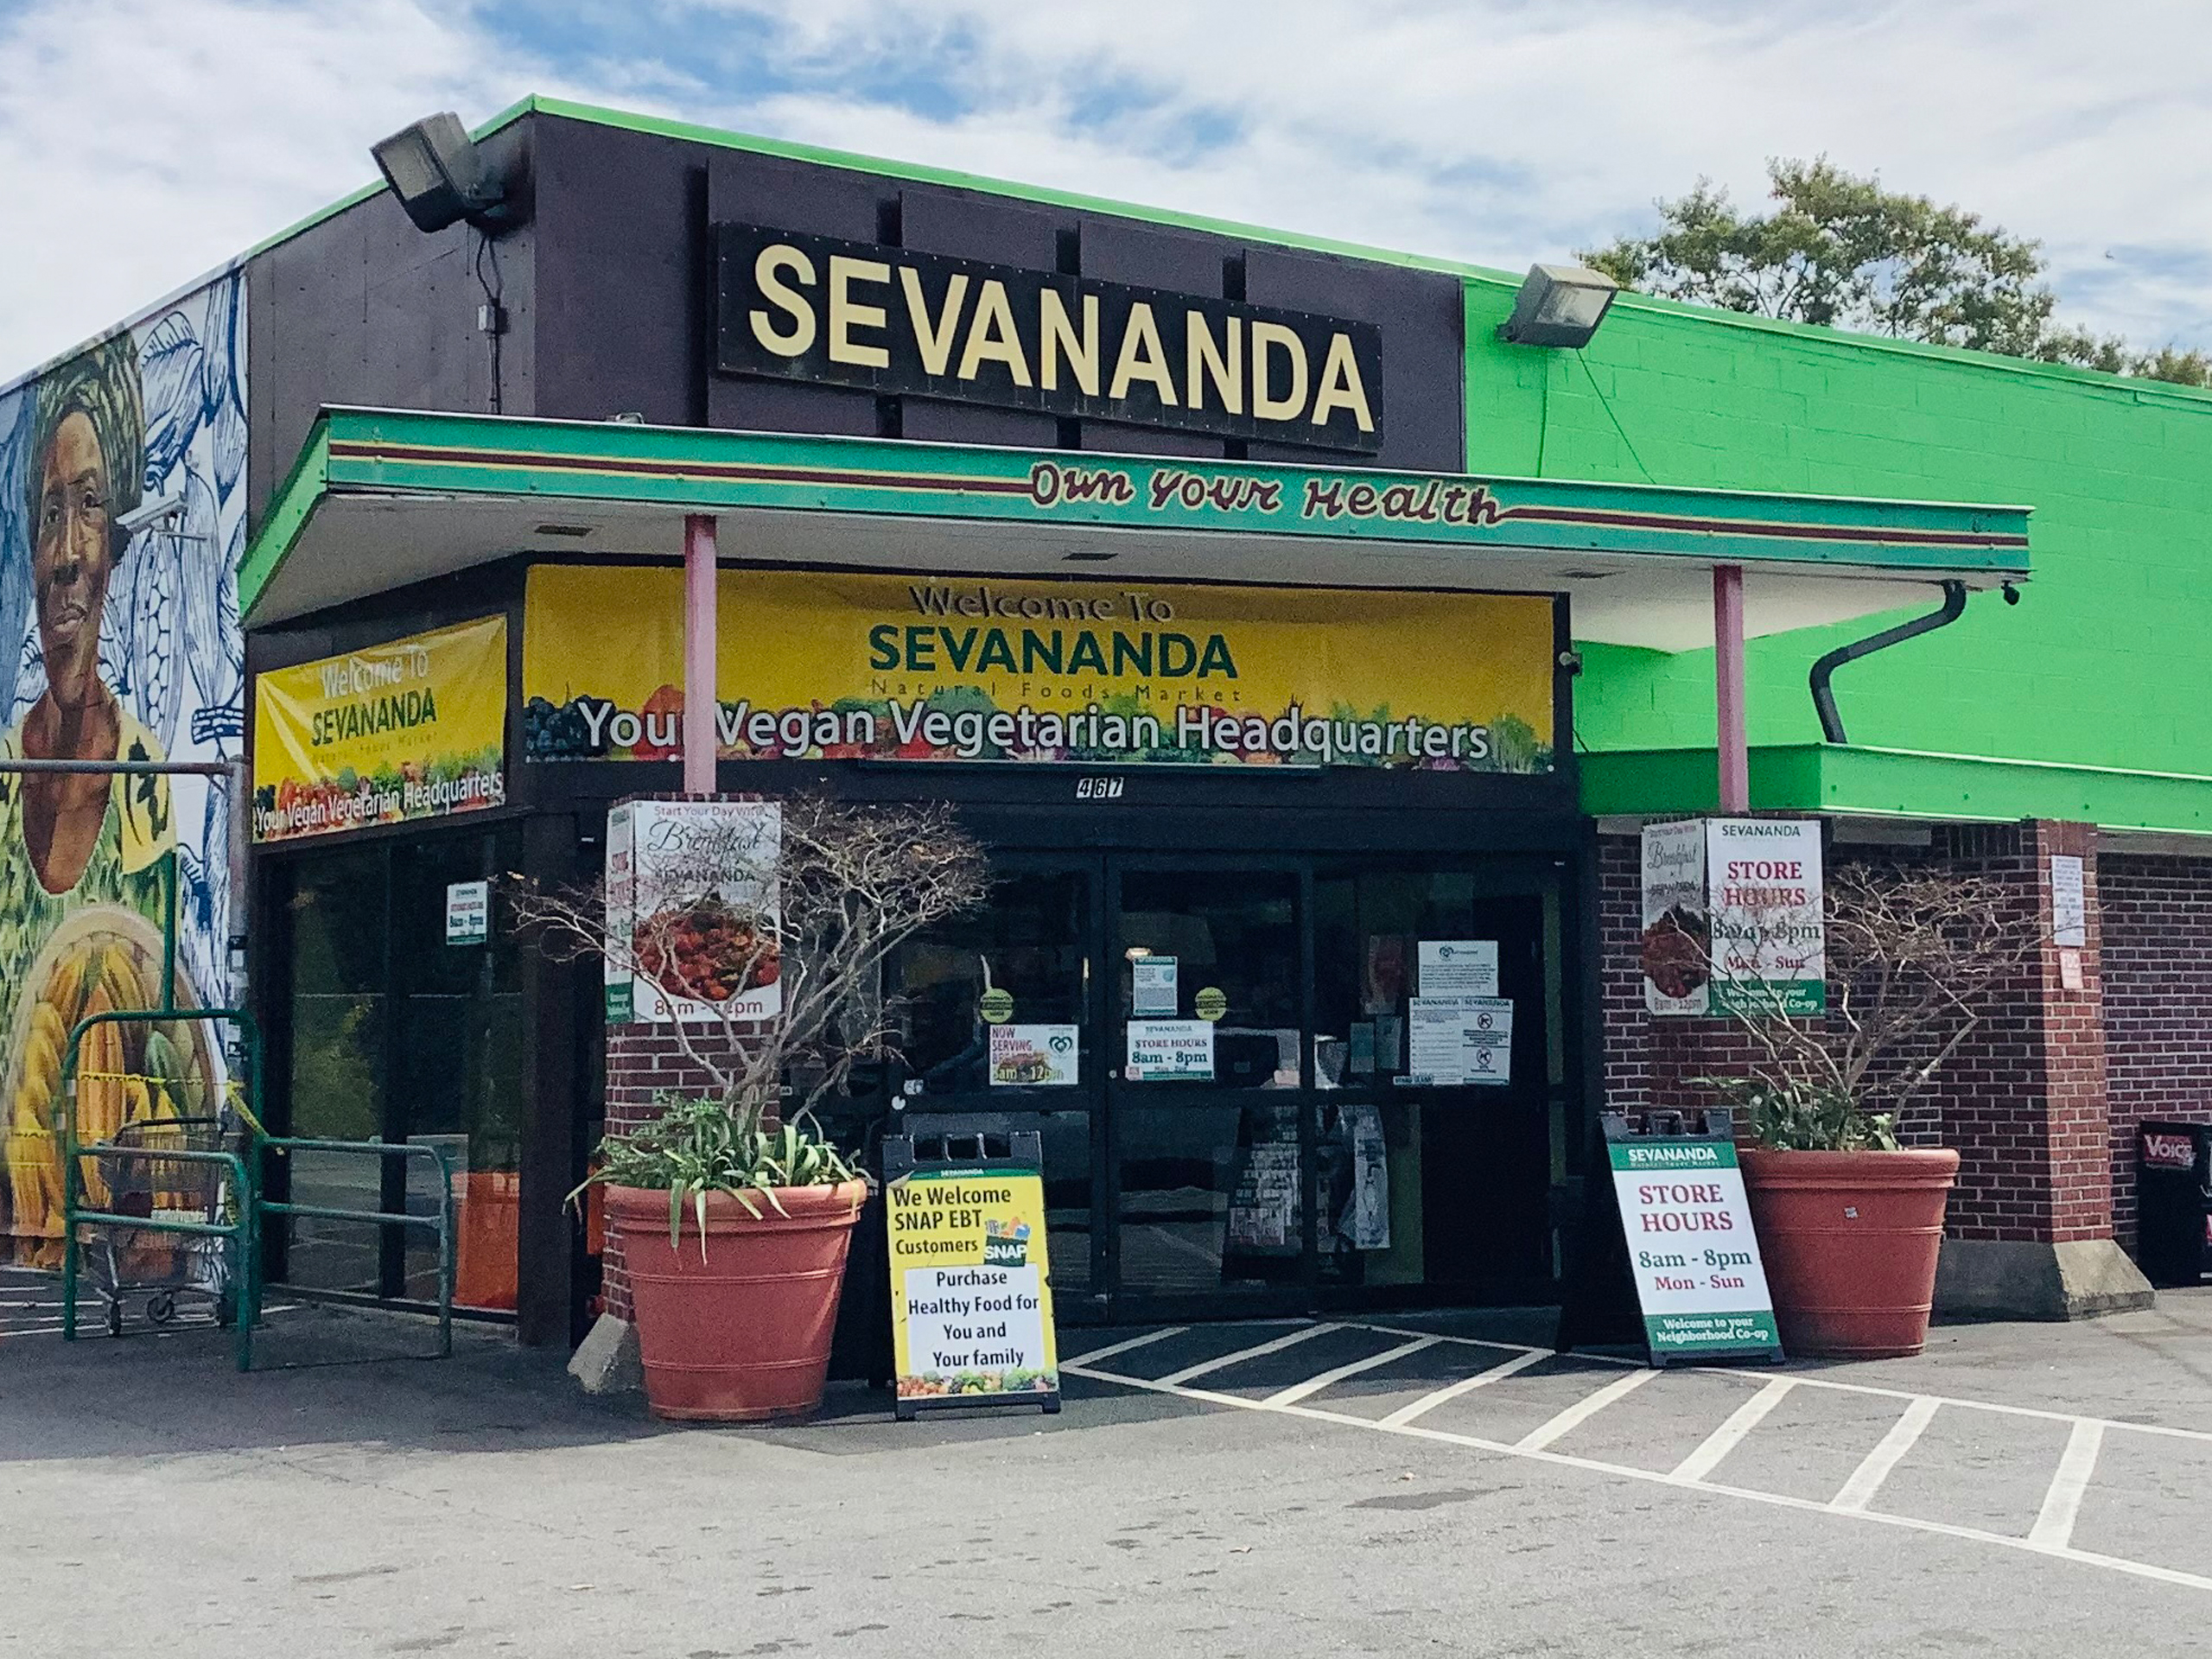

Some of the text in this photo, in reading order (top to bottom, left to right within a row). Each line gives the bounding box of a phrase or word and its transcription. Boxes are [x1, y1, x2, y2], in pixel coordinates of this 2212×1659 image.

[749, 244, 1376, 433] SEVANANDA
[1031, 463, 1135, 506] Own
[1303, 480, 1503, 526] Health
[909, 586, 1175, 623] Welcome To
[869, 625, 1238, 679] SEVANANDA
[321, 644, 429, 700] Welcome To
[872, 678, 1242, 702] Natural Foods Market
[311, 687, 437, 747] SEVANANDA
[577, 700, 1489, 762] You Vegan Vegetarian Headquarters
[1078, 778, 1122, 797] 467
[255, 772, 504, 832] Your Vegan Vegetarian Headquarters
[654, 805, 682, 817] Start
[684, 805, 709, 817] Your
[711, 805, 734, 818] Day
[1722, 824, 1802, 837] SEVANANDA
[1728, 861, 1803, 880] STORE
[1724, 887, 1807, 907] HOURS
[654, 1000, 695, 1016] 8m
[1789, 999, 1818, 1012] Co-op
[992, 1027, 1015, 1039] NOW
[992, 1039, 1033, 1052] SERVING
[1135, 1039, 1208, 1048] STORE HOURS
[1131, 1051, 1163, 1064] 8am
[1175, 1051, 1208, 1066] 8pm
[1627, 1147, 1719, 1162] SEVANANDA
[893, 1185, 1012, 1207] We Welcome
[1638, 1184, 1724, 1205] STORE
[895, 1209, 982, 1231] SNAP EBT
[1642, 1211, 1733, 1232] HOURS
[896, 1238, 979, 1255] Customers
[983, 1243, 1028, 1261] SNAP
[1638, 1250, 1687, 1268] 8am
[1705, 1249, 1753, 1271] 8pm
[937, 1271, 1007, 1287] Purchase
[1655, 1275, 1696, 1291] Mon
[1711, 1274, 1745, 1289] Sun
[908, 1294, 1039, 1319] Healthy Food for
[944, 1322, 1007, 1341] You and
[1662, 1318, 1754, 1332] Welcome to your
[1656, 1328, 1769, 1344] Neighborhood Co-op
[933, 1348, 1025, 1368] Your family
